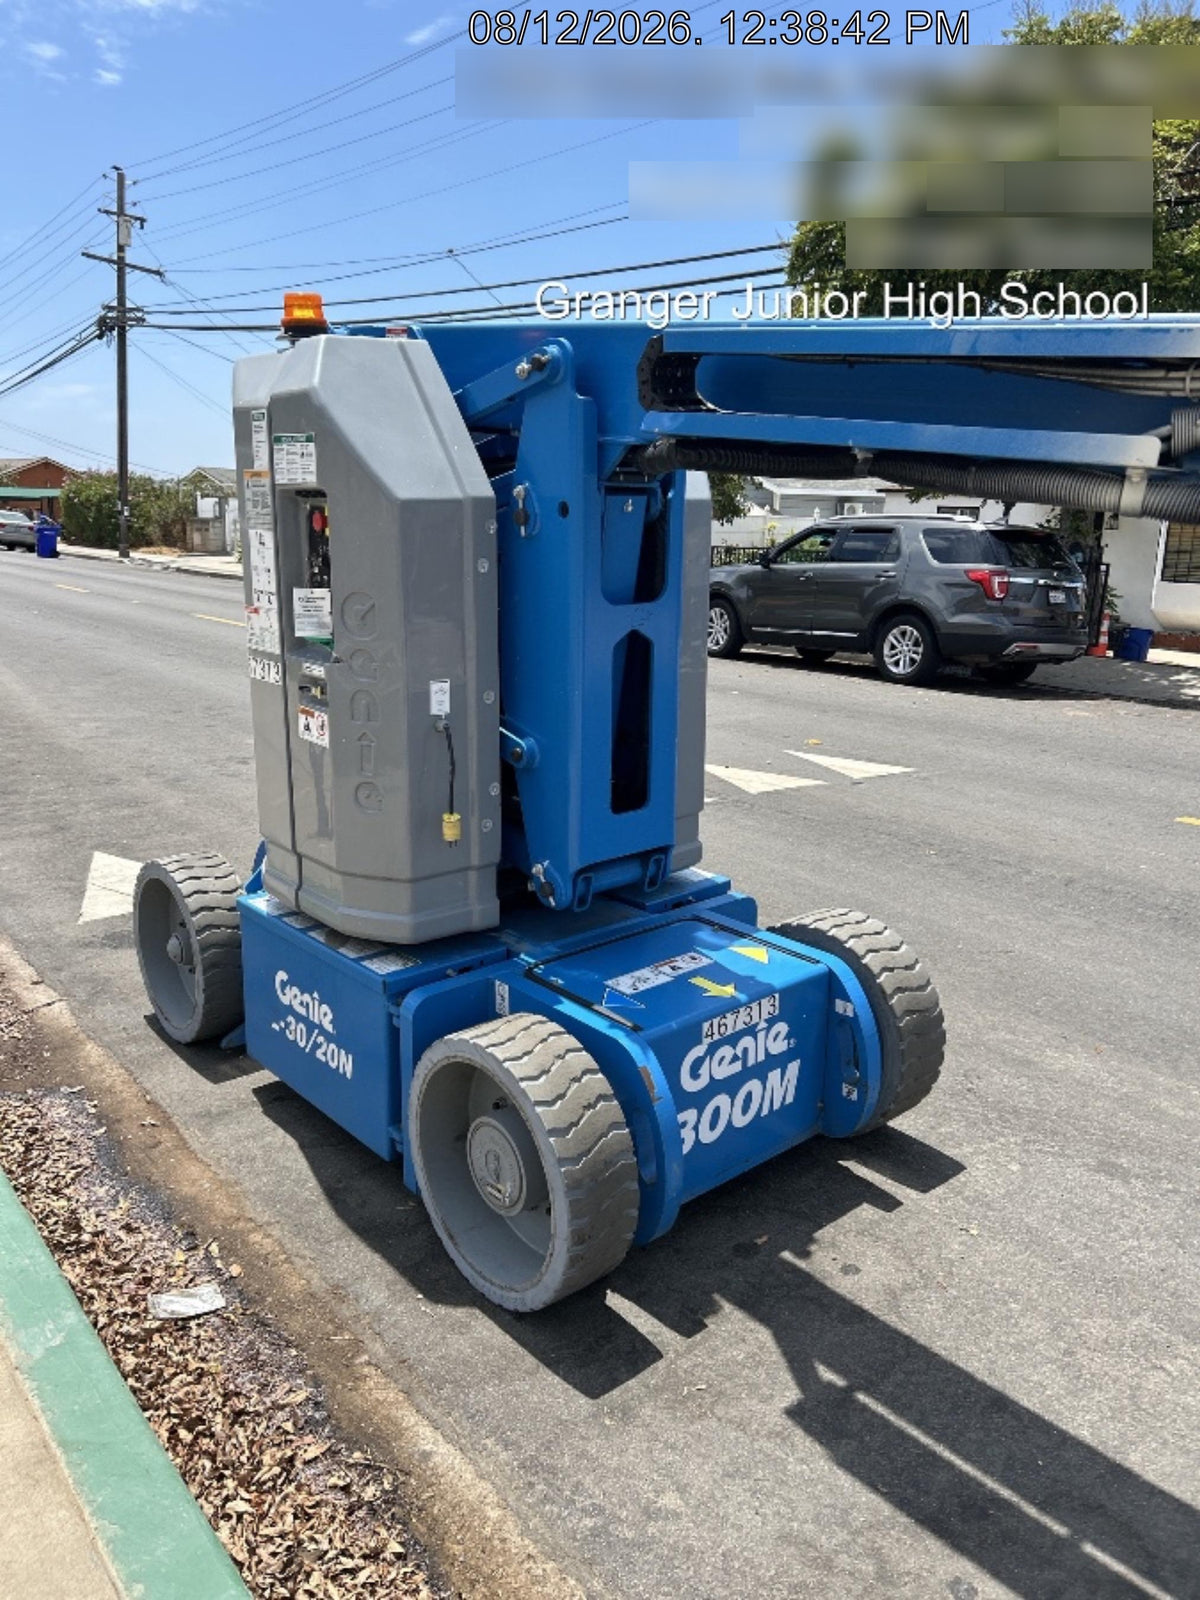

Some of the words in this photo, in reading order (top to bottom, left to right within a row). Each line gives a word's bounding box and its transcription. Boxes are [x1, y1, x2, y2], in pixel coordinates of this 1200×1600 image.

[275, 970, 334, 1034] Genie
[703, 993, 778, 1041] 467313
[271, 1015, 353, 1080] -30/20N
[680, 1021, 790, 1092] Genie
